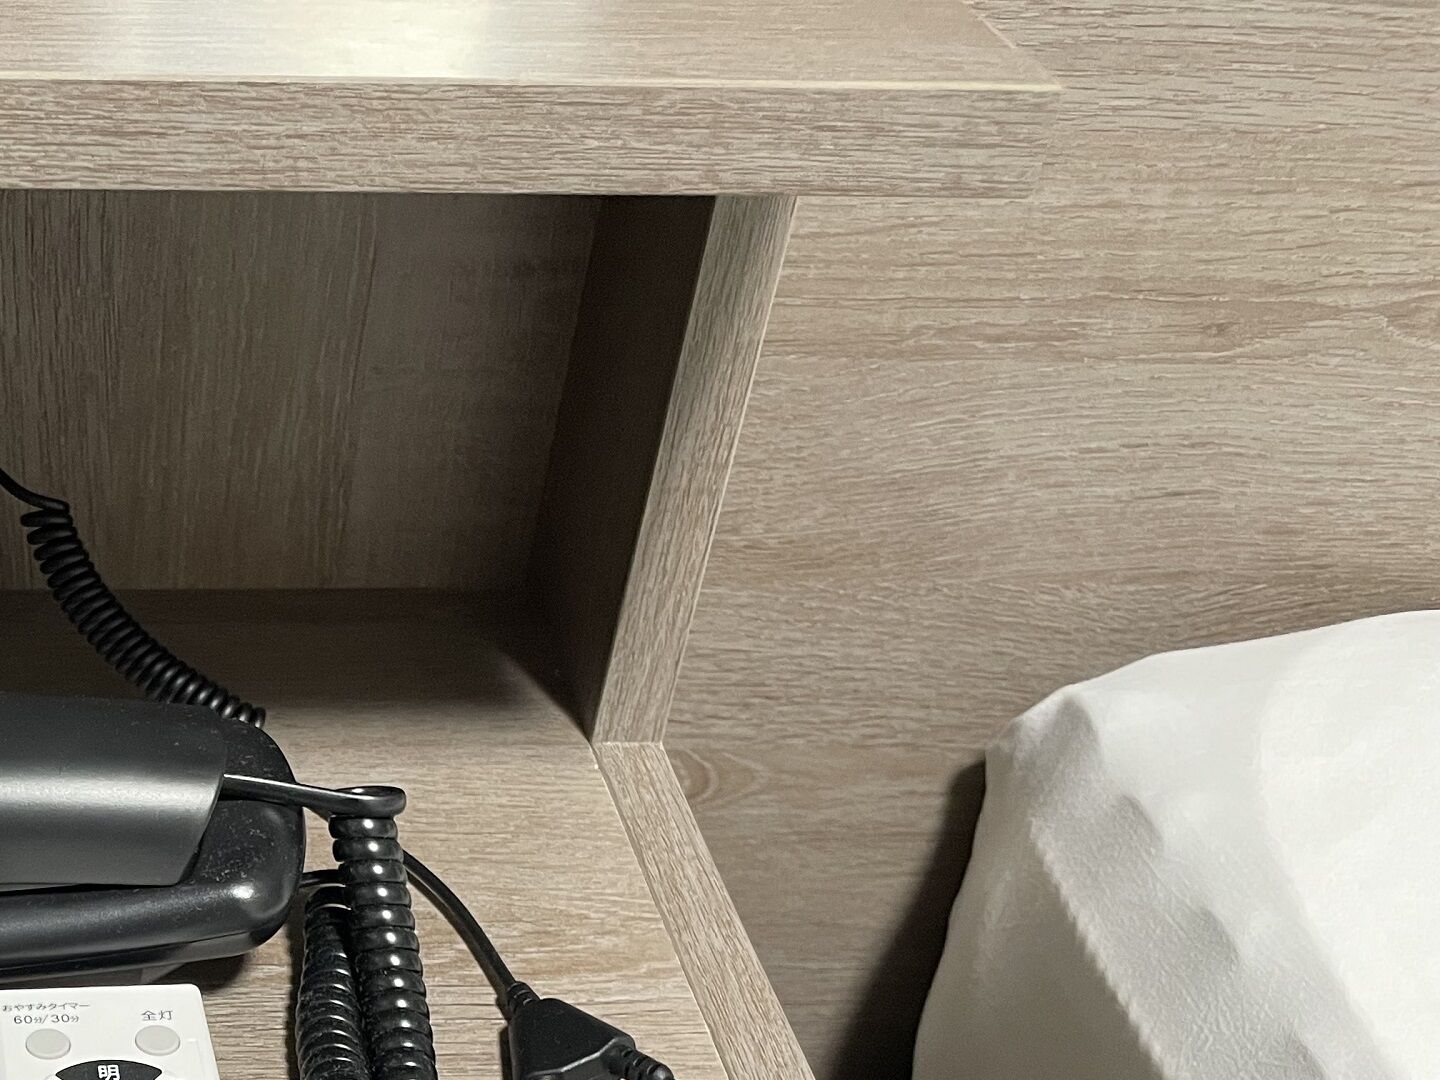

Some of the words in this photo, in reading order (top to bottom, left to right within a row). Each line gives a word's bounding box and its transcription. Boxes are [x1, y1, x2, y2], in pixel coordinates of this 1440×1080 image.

[1, 1001, 91, 1012] おやすみタイマー
[141, 1010, 173, 1022] 全灯
